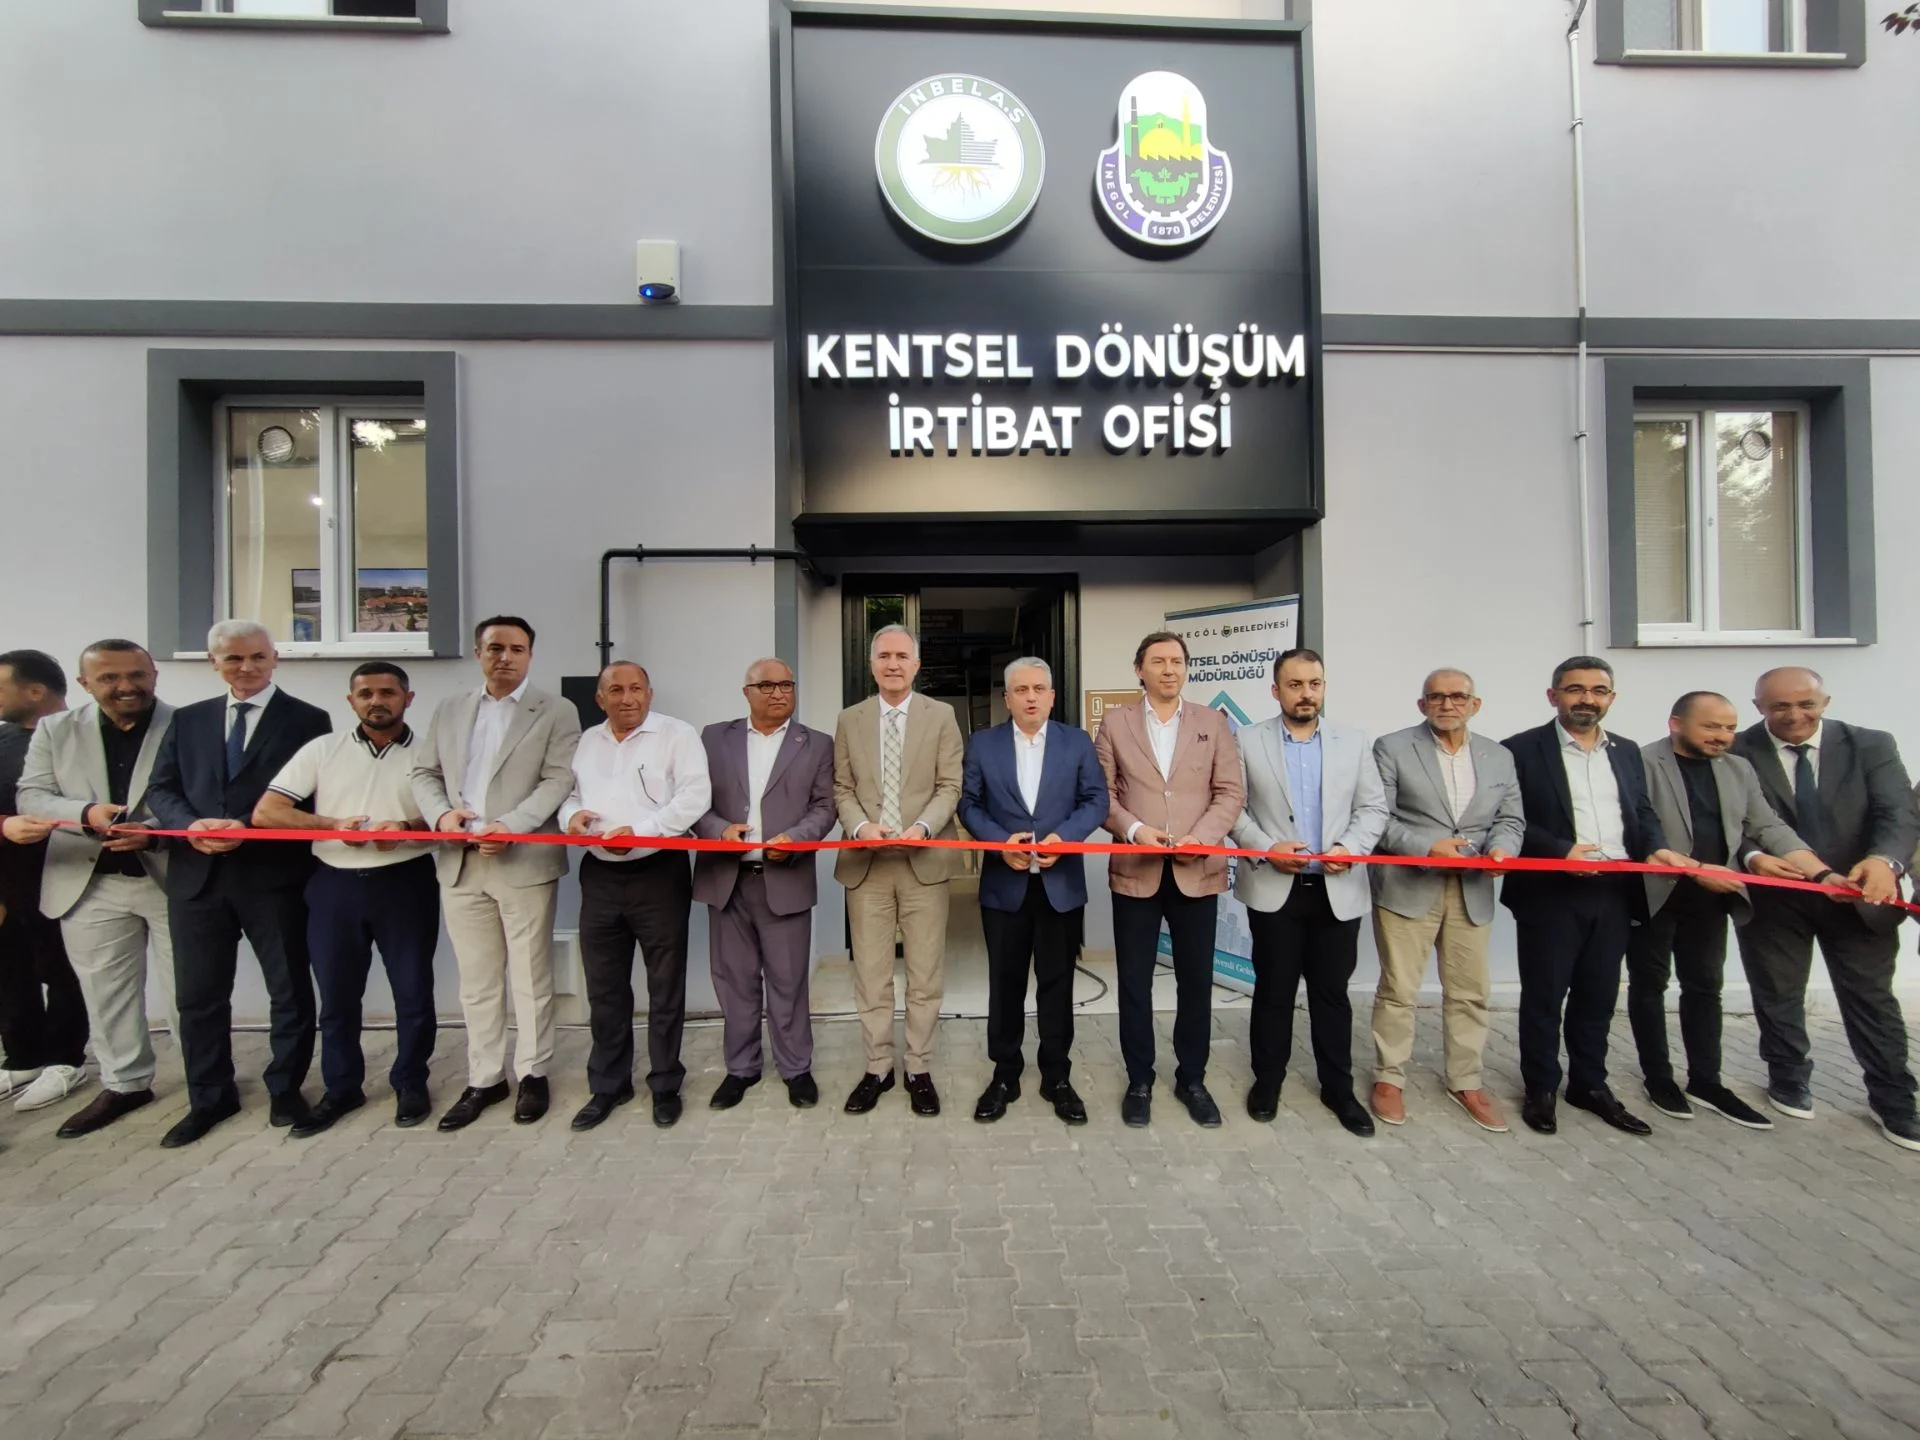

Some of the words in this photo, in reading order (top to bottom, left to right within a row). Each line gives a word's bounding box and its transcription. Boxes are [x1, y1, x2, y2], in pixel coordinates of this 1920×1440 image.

[1151, 225, 1181, 235] 1870
[806, 333, 1033, 378] KENTSEL
[1056, 322, 1306, 389] DÖNÜŞÜM
[888, 393, 1082, 451] İRTİBAT
[1103, 393, 1232, 450] OFİSİ
[1233, 618, 1289, 634] BELEDİYESİ
[1188, 665, 1265, 683] MÜDÜRLÜĞÜ
